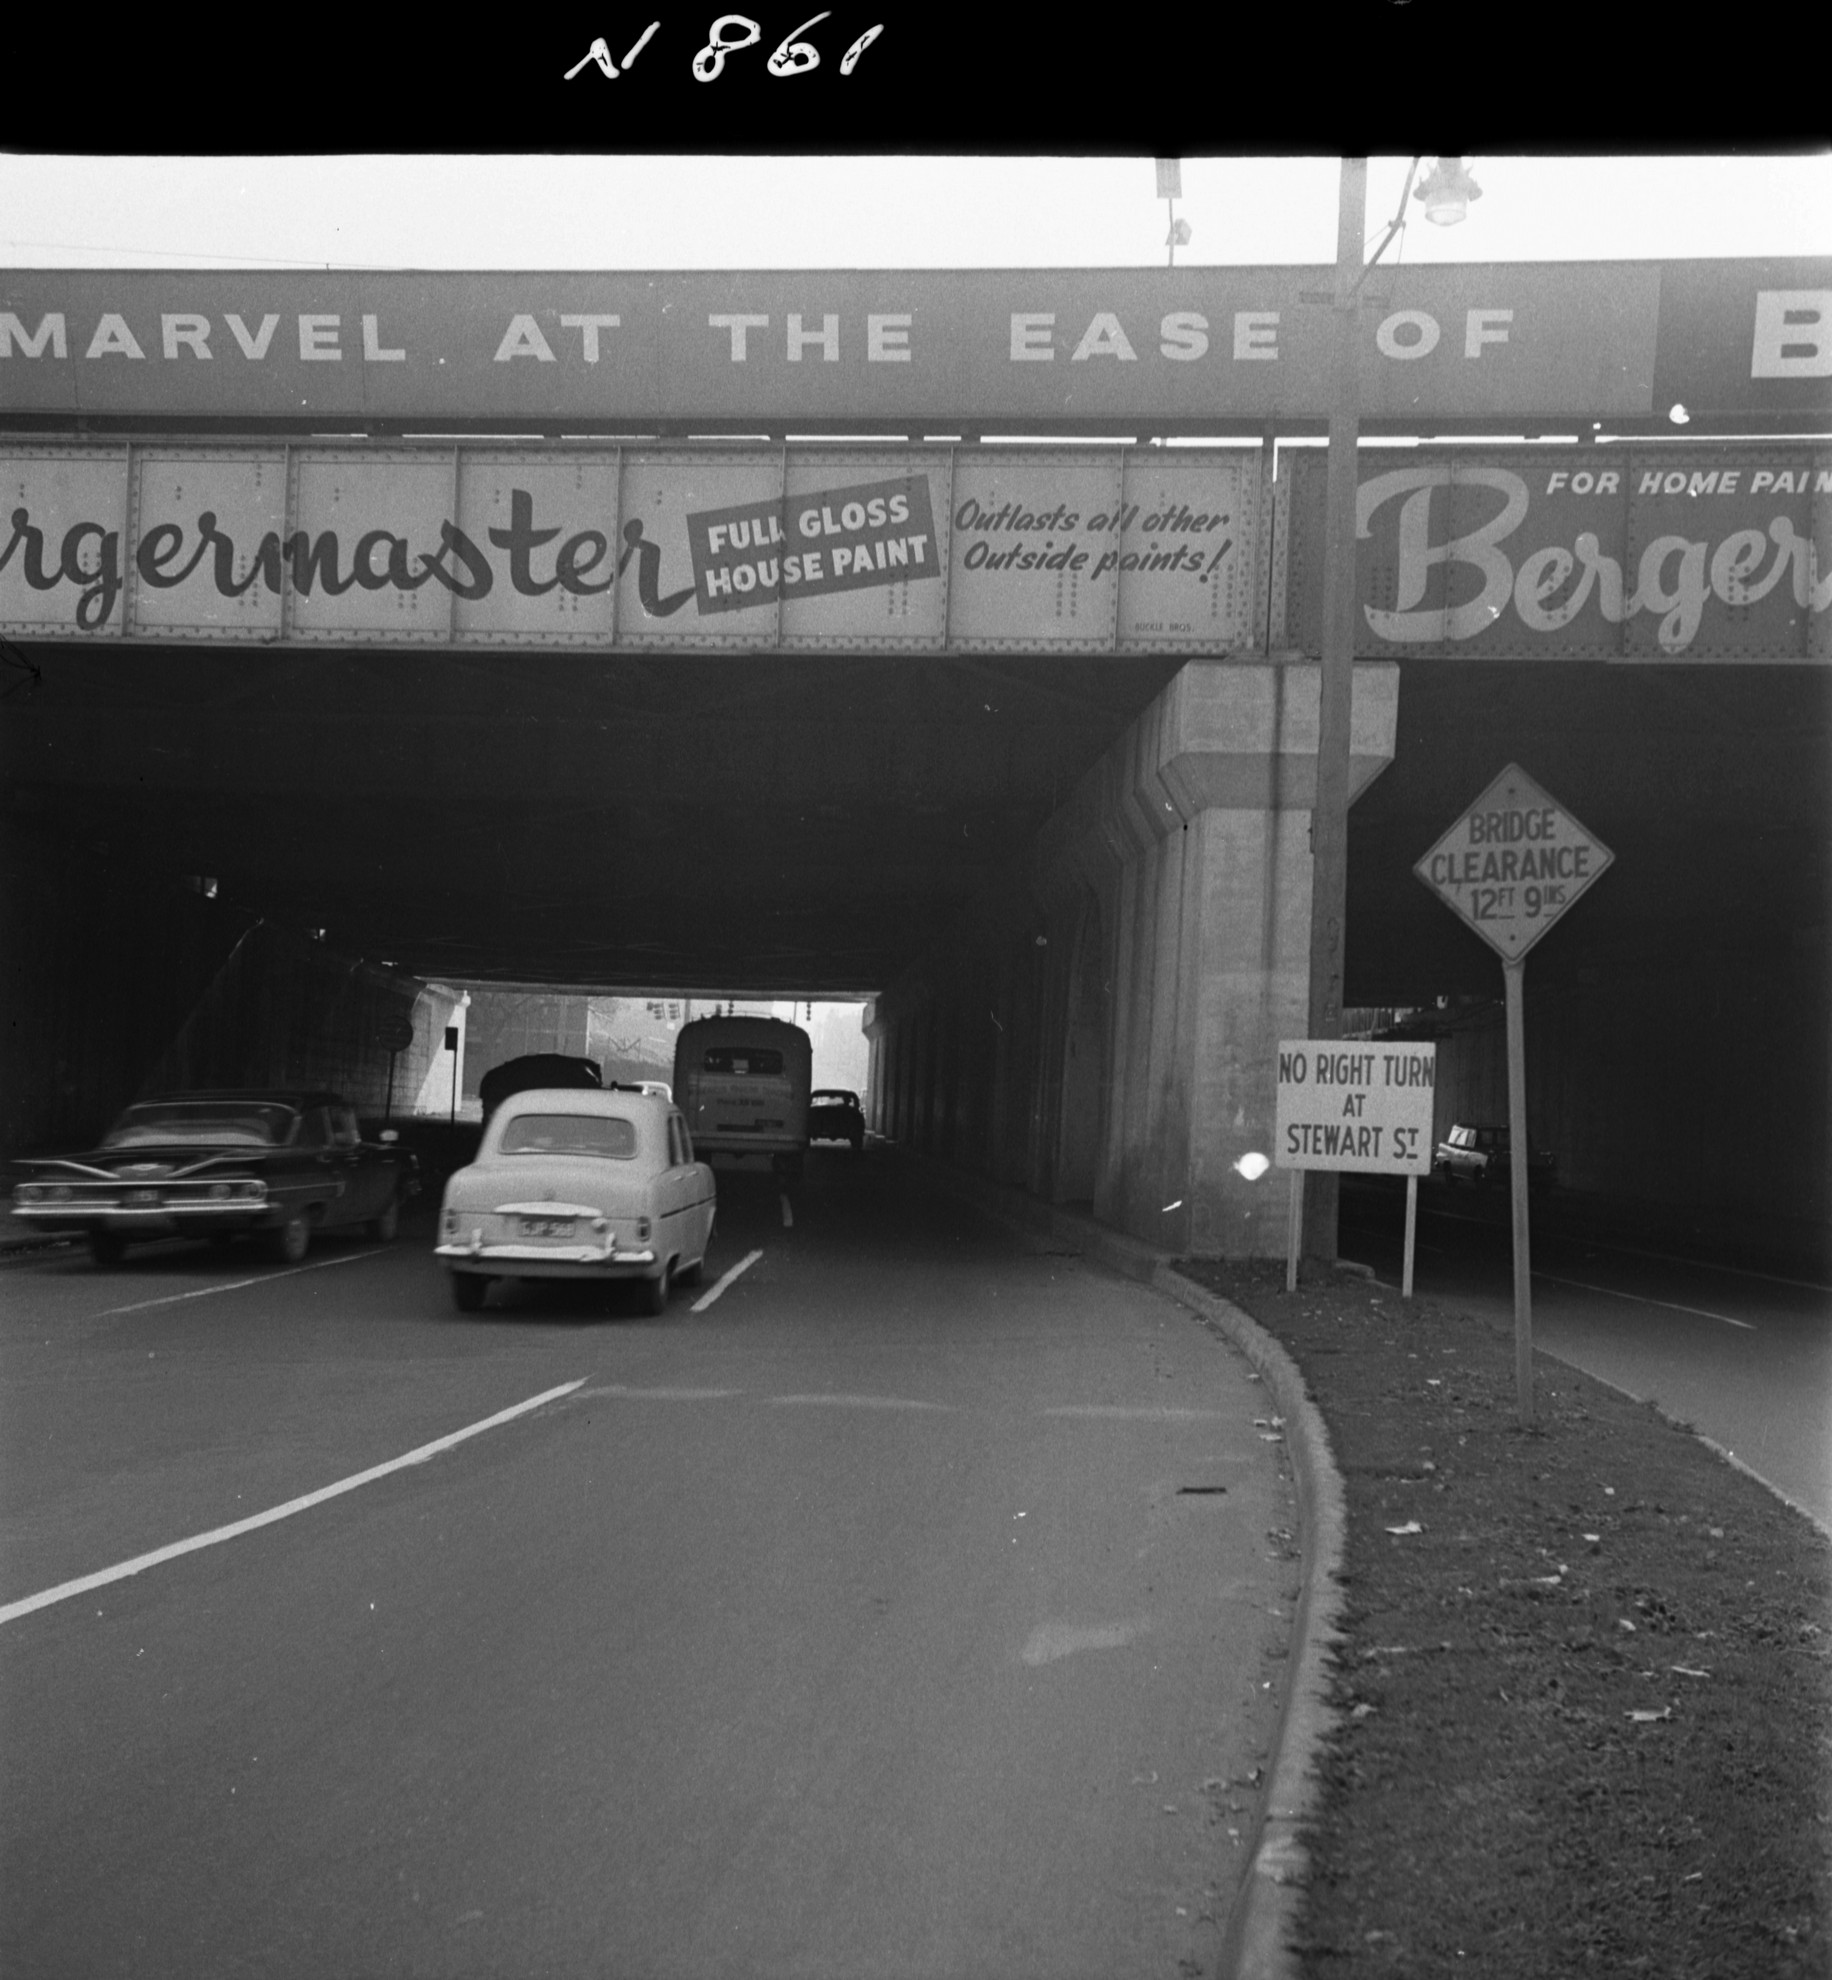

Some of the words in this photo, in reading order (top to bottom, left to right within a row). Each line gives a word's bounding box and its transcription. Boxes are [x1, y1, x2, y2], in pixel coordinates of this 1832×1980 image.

[0, 312, 406, 362] MARVEL
[493, 314, 621, 362] AT
[708, 313, 912, 362] THE
[1009, 311, 1281, 360] EASE
[1376, 309, 1514, 360] OF
[1546, 472, 1620, 495] FOR
[1638, 471, 1741, 495] HOME
[708, 516, 786, 554] FULL
[799, 495, 909, 538] GLOSS
[955, 498, 1080, 532] Outlasts
[1086, 502, 1140, 533] all
[1142, 504, 1230, 533] other
[705, 551, 824, 598] HOUSE
[831, 534, 928, 576] PAINT
[963, 540, 1090, 572] Outside
[1090, 538, 1233, 584] paints!
[1468, 808, 1556, 845] BRIDGE
[1430, 845, 1590, 885] CLEARANCE
[1279, 1053, 1307, 1084] NO
[1316, 1054, 1376, 1086] RIGHT
[1383, 1055, 1435, 1088] TURN
[1342, 1093, 1366, 1117] AT
[1287, 1123, 1383, 1158] STEWART
